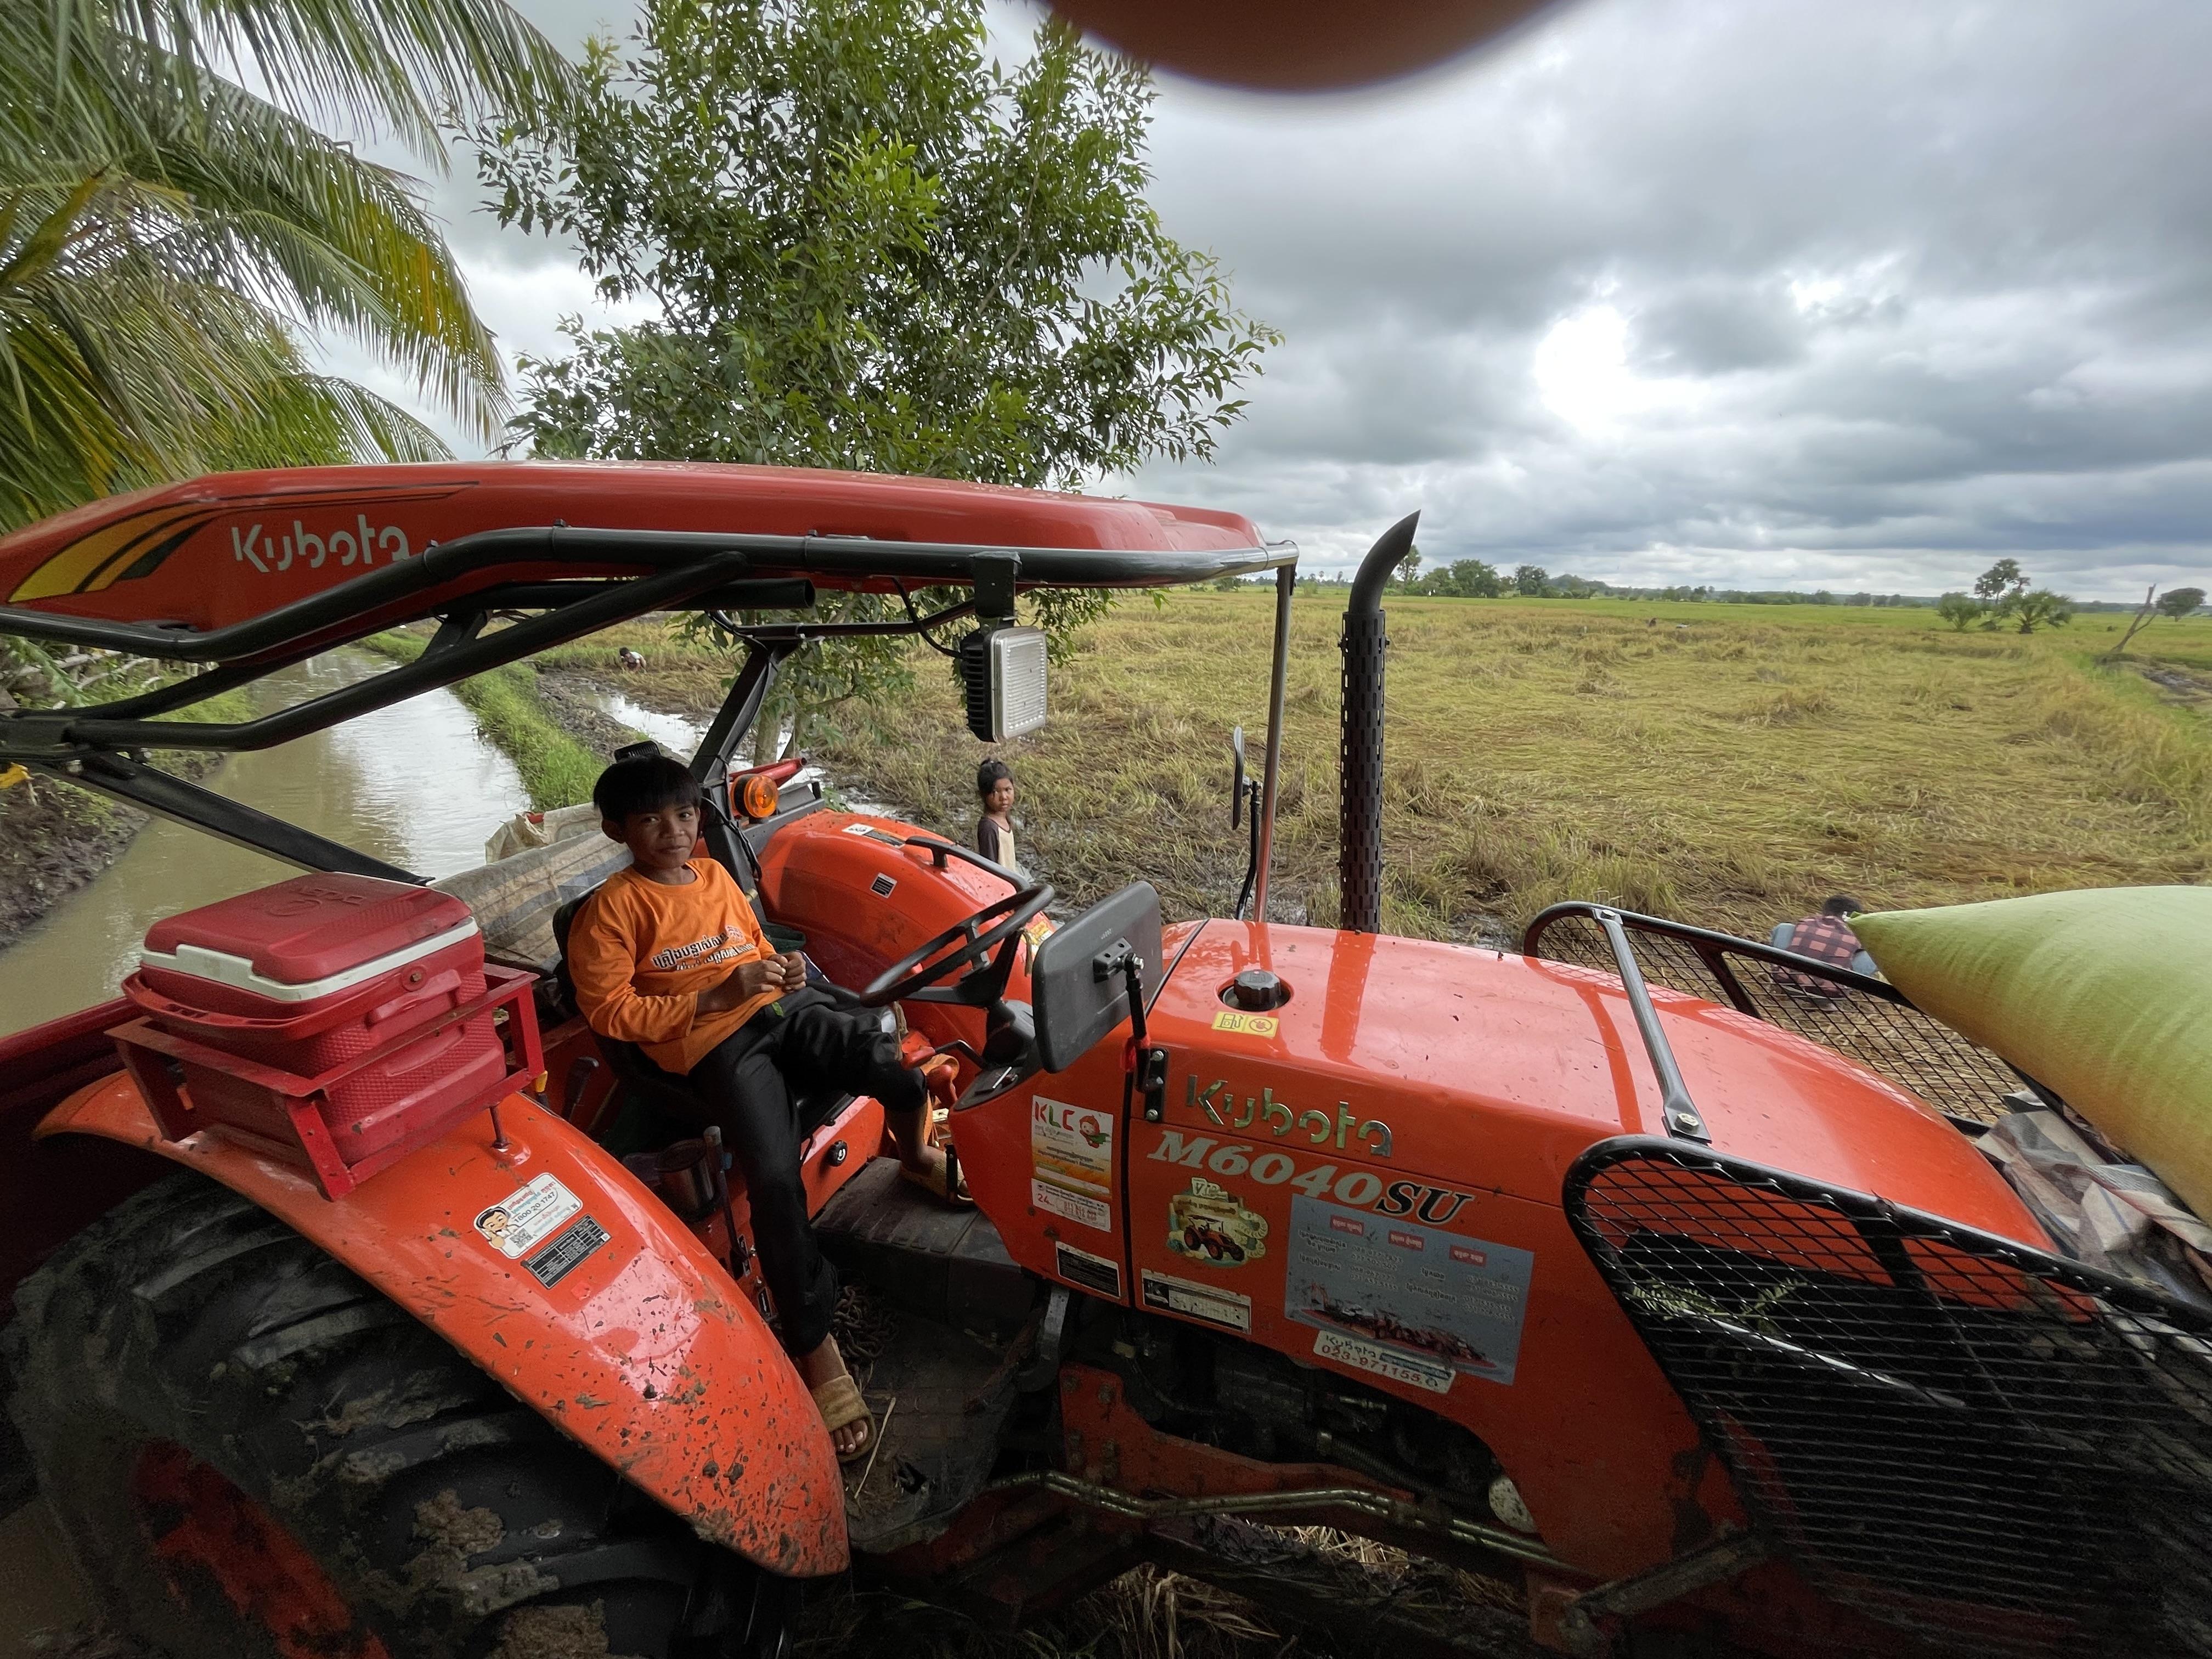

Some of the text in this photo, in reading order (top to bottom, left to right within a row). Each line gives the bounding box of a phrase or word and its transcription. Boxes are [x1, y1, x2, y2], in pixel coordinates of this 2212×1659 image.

[231, 514, 410, 573] Kubota
[1035, 1101, 1075, 1132] KLC
[1186, 1074, 1393, 1158] Kubota
[1147, 1130, 1475, 1225] M6040SU
